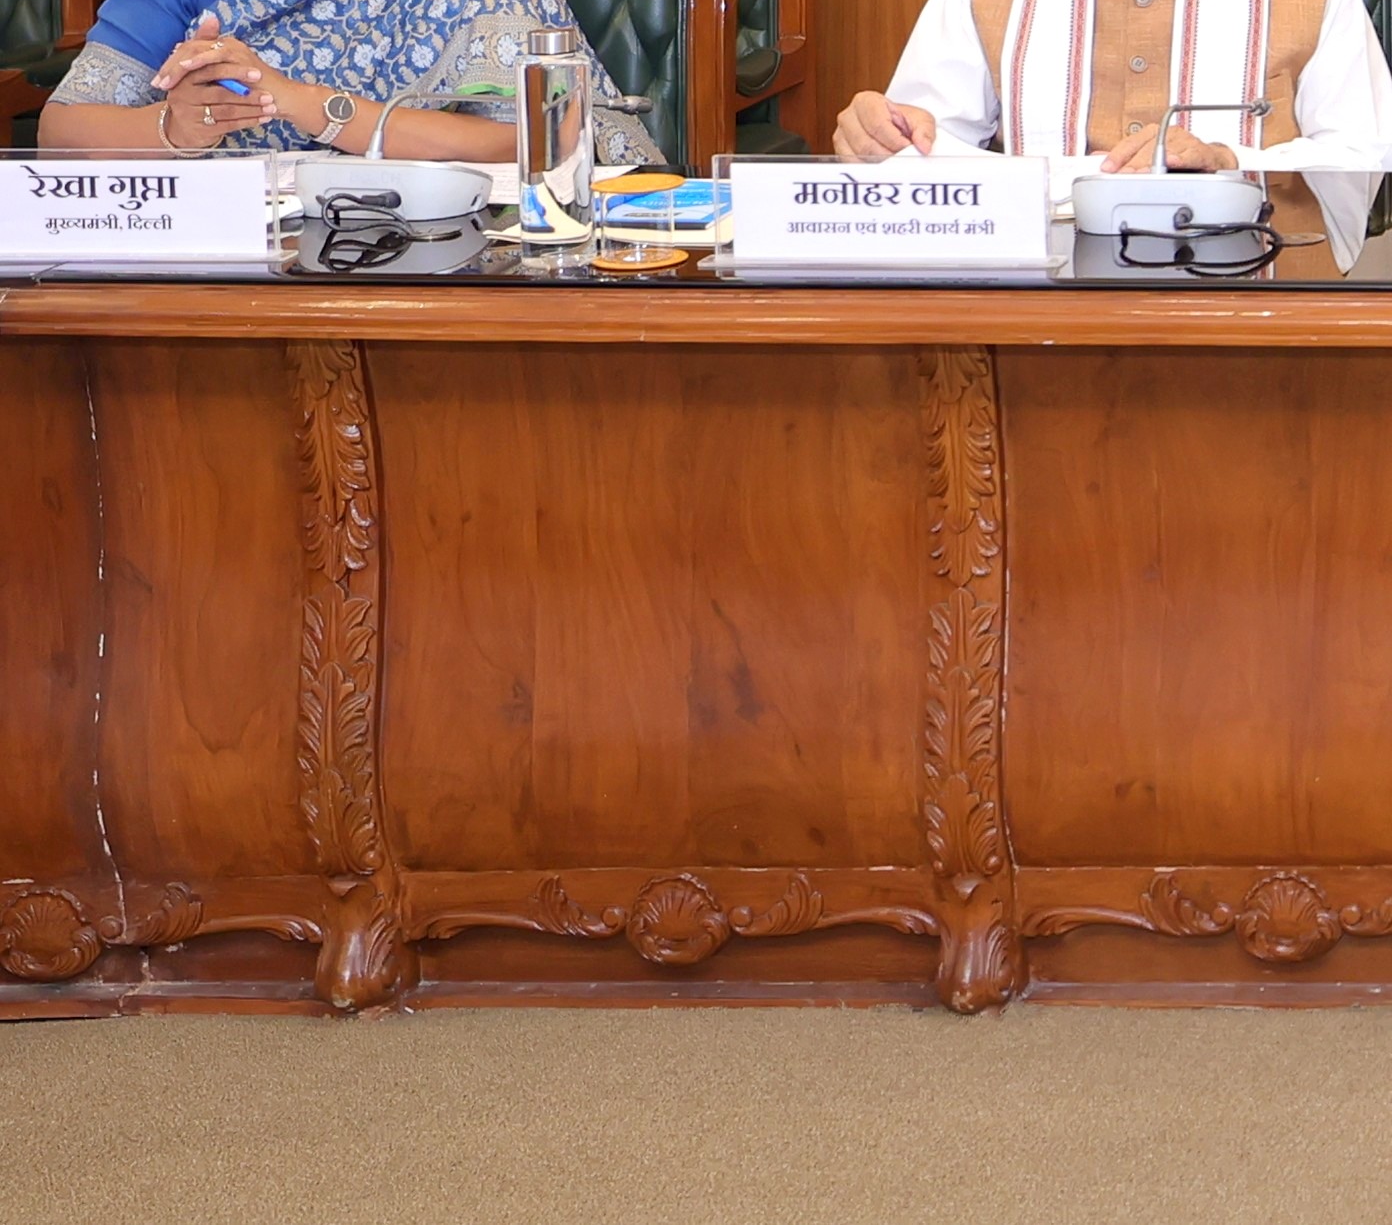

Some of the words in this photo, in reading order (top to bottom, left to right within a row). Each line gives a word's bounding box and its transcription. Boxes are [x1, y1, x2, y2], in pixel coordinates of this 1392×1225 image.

[19, 165, 100, 199] रेखा
[107, 175, 180, 211] गुप्ता
[792, 172, 903, 208] मनोहर
[909, 183, 982, 206] लाल
[45, 213, 123, 235] मुख्यमंत्री,
[127, 213, 173, 231] दिल्ली
[787, 221, 852, 234] आवासन
[855, 218, 878, 235] एवं
[881, 218, 921, 235] शहरी
[924, 219, 960, 235] कार्य
[963, 219, 995, 235] मंत्री
